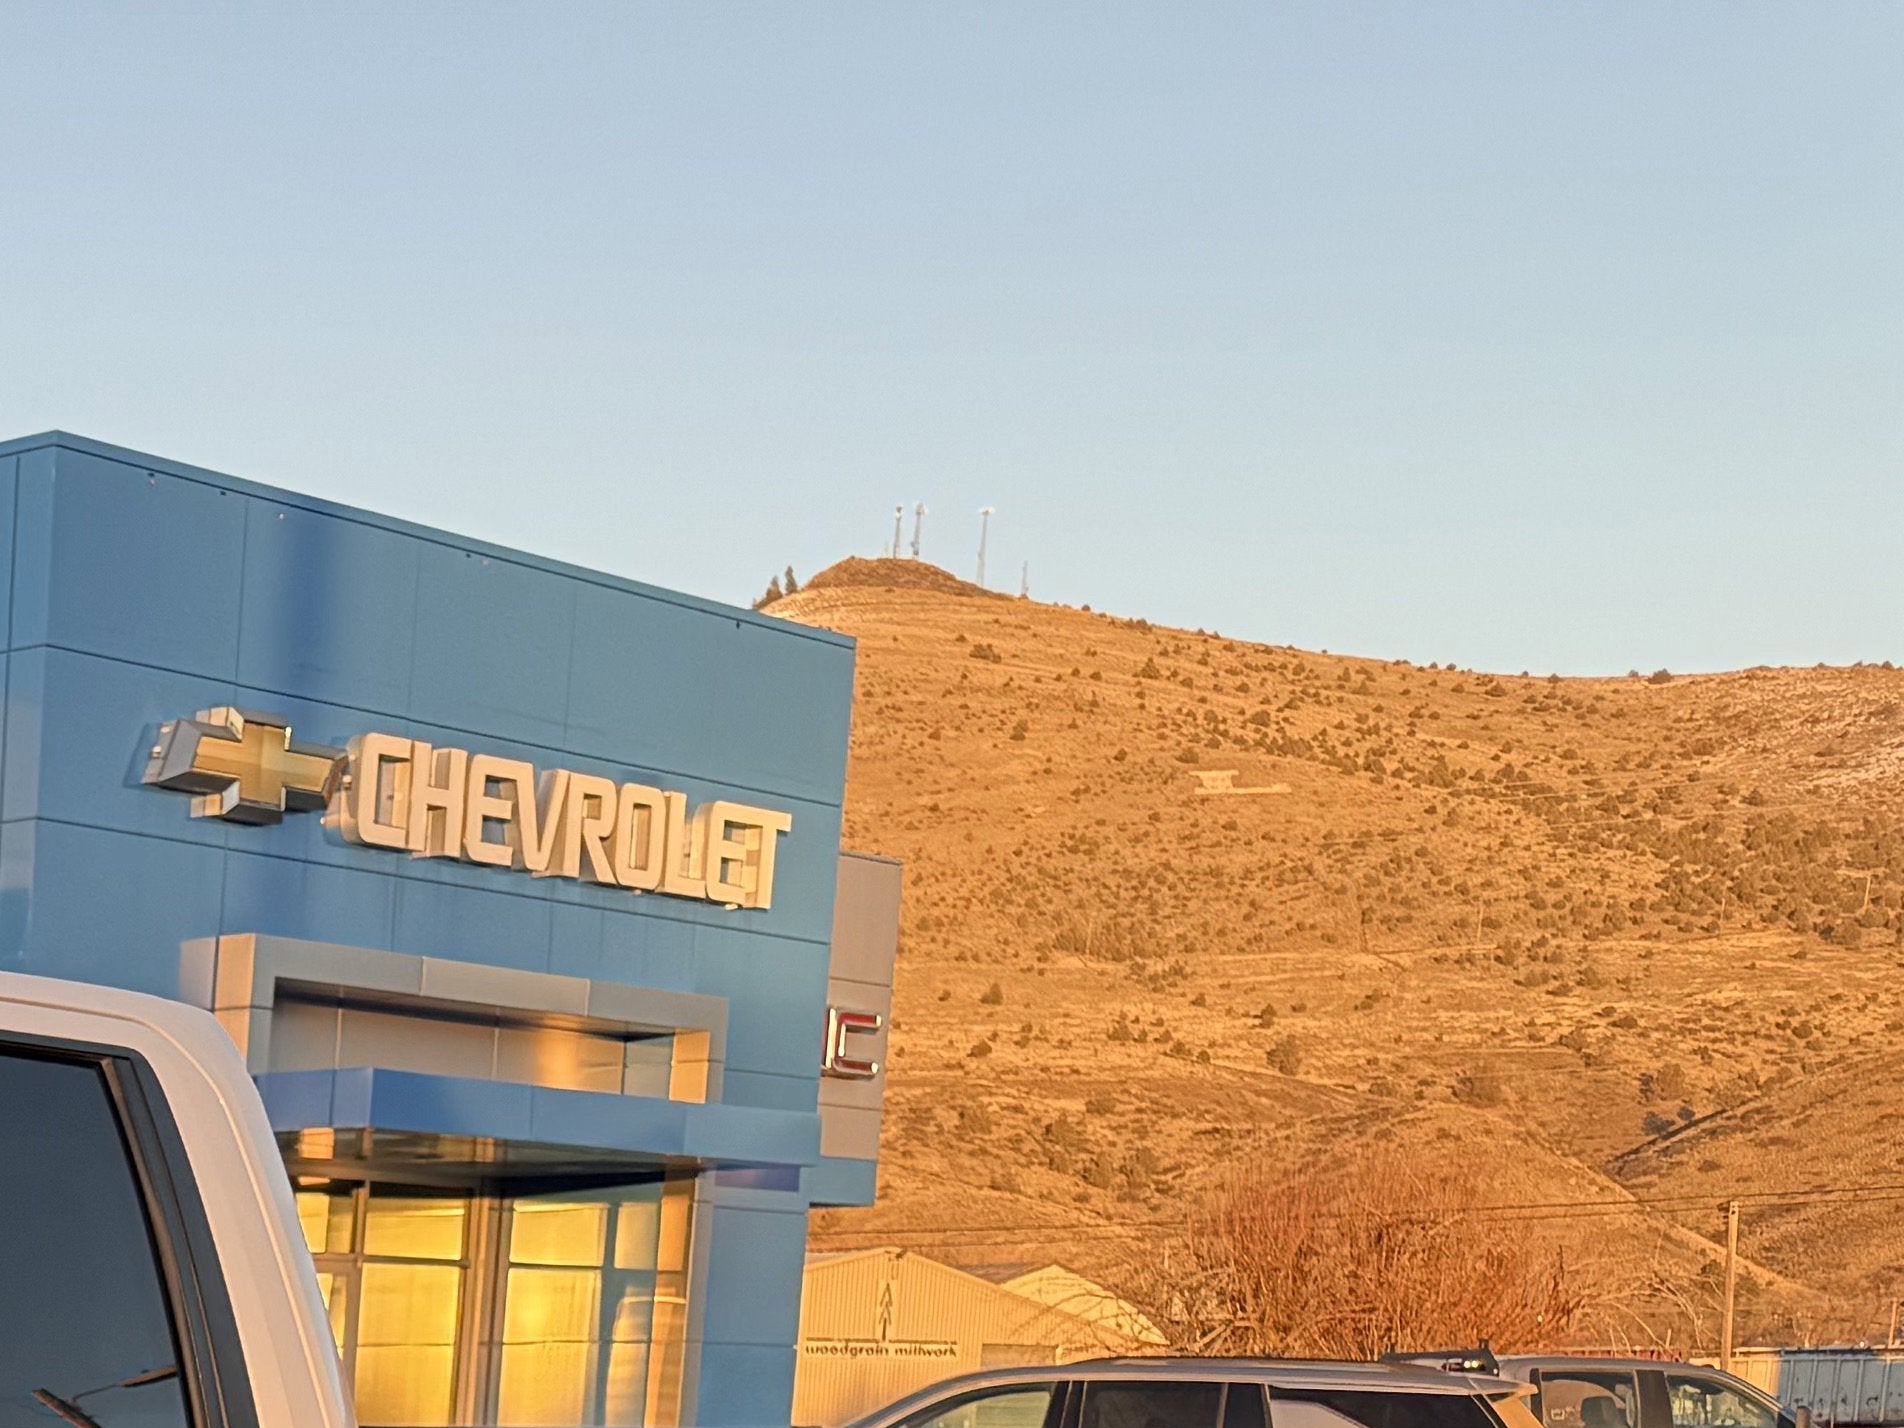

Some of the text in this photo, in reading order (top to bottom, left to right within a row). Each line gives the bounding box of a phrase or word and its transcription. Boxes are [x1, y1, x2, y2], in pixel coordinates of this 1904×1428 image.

[352, 732, 792, 911] CHEVROLET
[805, 1343, 958, 1360] woodgrain millwork
